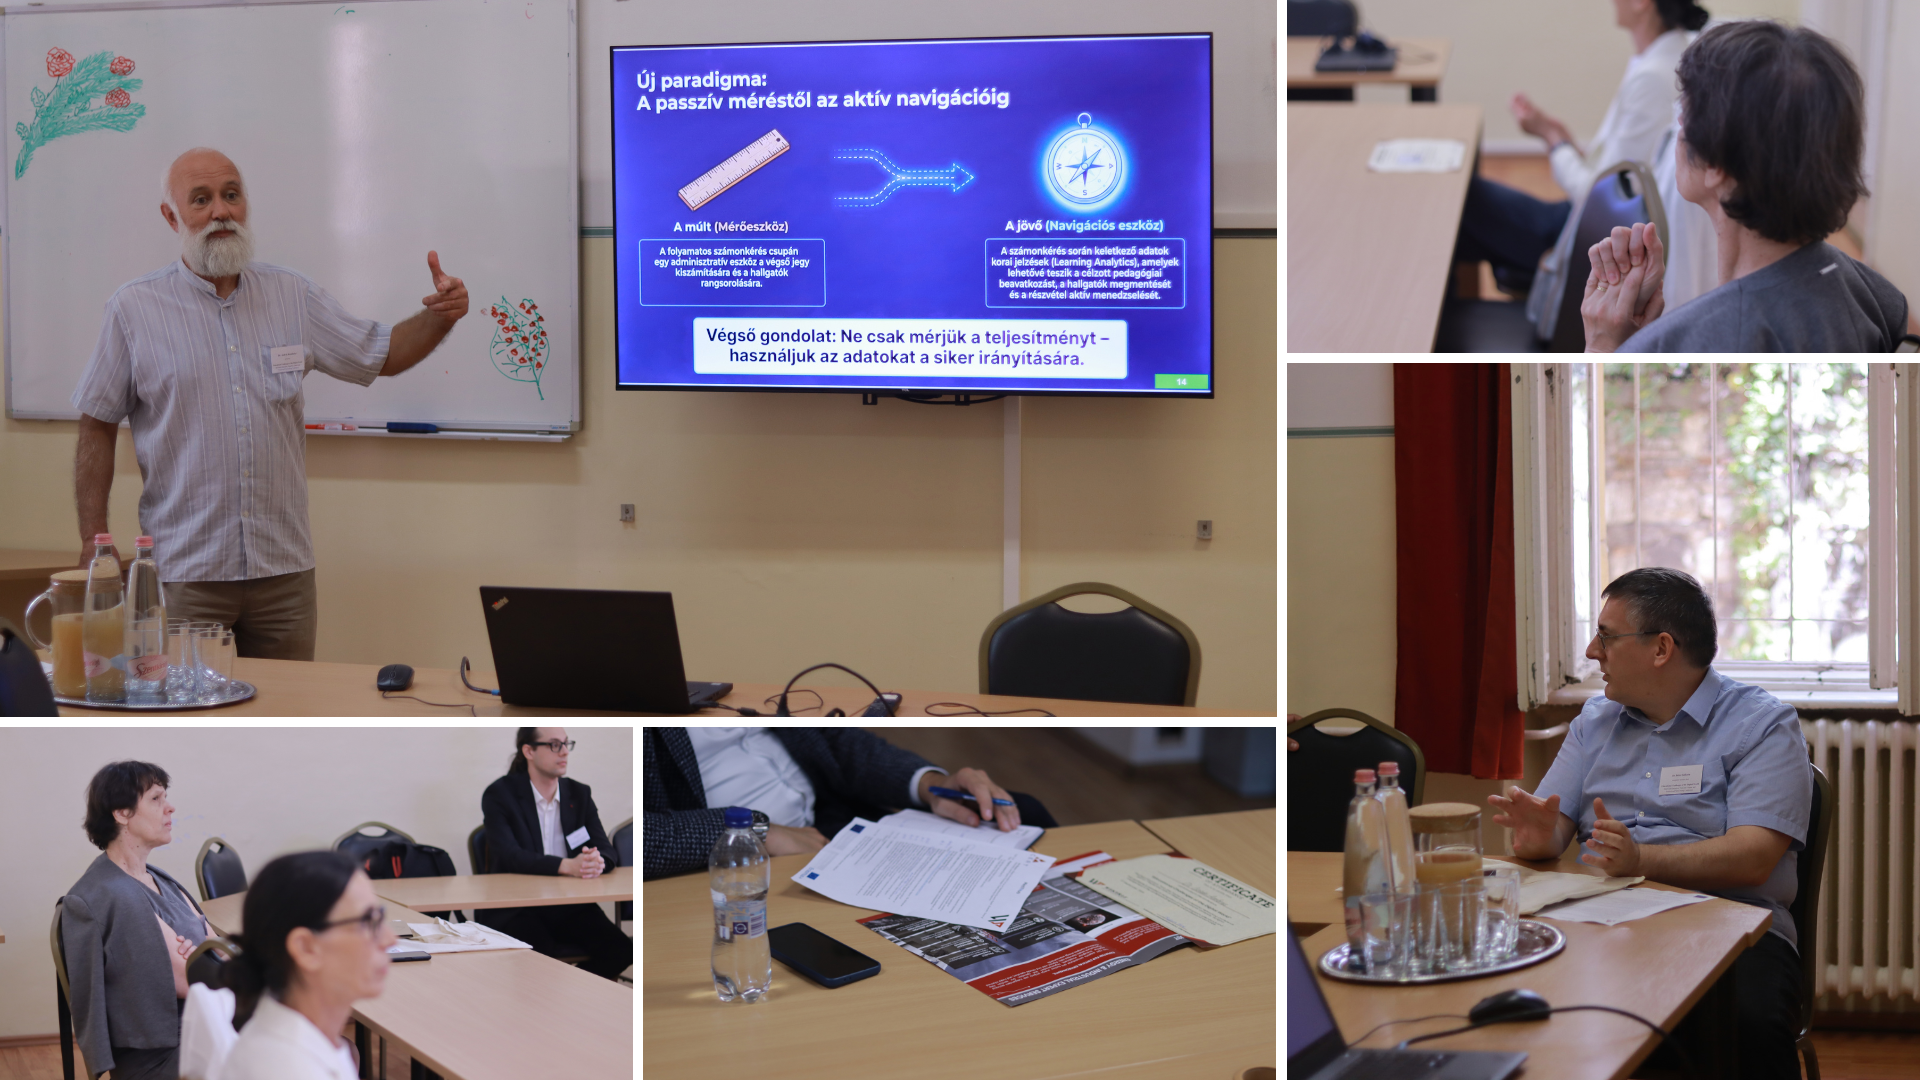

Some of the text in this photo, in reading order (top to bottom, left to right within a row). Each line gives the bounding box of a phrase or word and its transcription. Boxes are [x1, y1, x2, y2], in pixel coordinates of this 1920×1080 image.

[637, 70, 768, 92] Új paradigma:
[637, 88, 1010, 114] A passzív méréstől az aktív navigációig
[673, 221, 789, 233] A múlt (Mérőeszköz)
[1005, 220, 1164, 233] A jövő (Navigációs eszköz)
[660, 247, 798, 258] A folyamatos számonkérés csupán
[1001, 246, 1169, 255] A számonkérés során keletkező adatok
[654, 259, 669, 268] egy
[671, 258, 729, 266] adminisztratív
[730, 258, 757, 266] eszköz
[766, 258, 790, 268] végső
[791, 258, 810, 268] jegy
[991, 257, 1179, 268] korai jelzések (Learning Analytics), amelyek
[675, 268, 730, 277] kiszámítására
[732, 268, 742, 277] és
[750, 268, 788, 278] hallgatók
[1008, 268, 1044, 277] lehetővé
[1046, 269, 1072, 277] teszik
[1081, 268, 1111, 277] célzott
[1113, 268, 1162, 279] pedagógiai
[701, 279, 763, 289] rangsorolására.
[999, 279, 1057, 289] beavatkozást,
[1067, 279, 1107, 291] hallgatók
[1110, 280, 1171, 290] megmentését
[1009, 290, 1019, 299] és
[1029, 290, 1067, 299] részvétel
[1069, 290, 1090, 299] aktív
[1093, 291, 1161, 300] menedzselését.
[706, 328, 756, 344] Végső
[760, 329, 836, 345] gondolat:
[841, 329, 862, 343] Ne
[867, 330, 905, 343] csak
[909, 329, 967, 347] mérjük
[971, 334, 981, 344] a
[985, 330, 1096, 348] teljesítményt
[730, 348, 1084, 368] használjuk az adatokat a siker irányítására.
[1176, 378, 1187, 386] 14
[1193, 866, 1274, 909] CERTIFICATE
